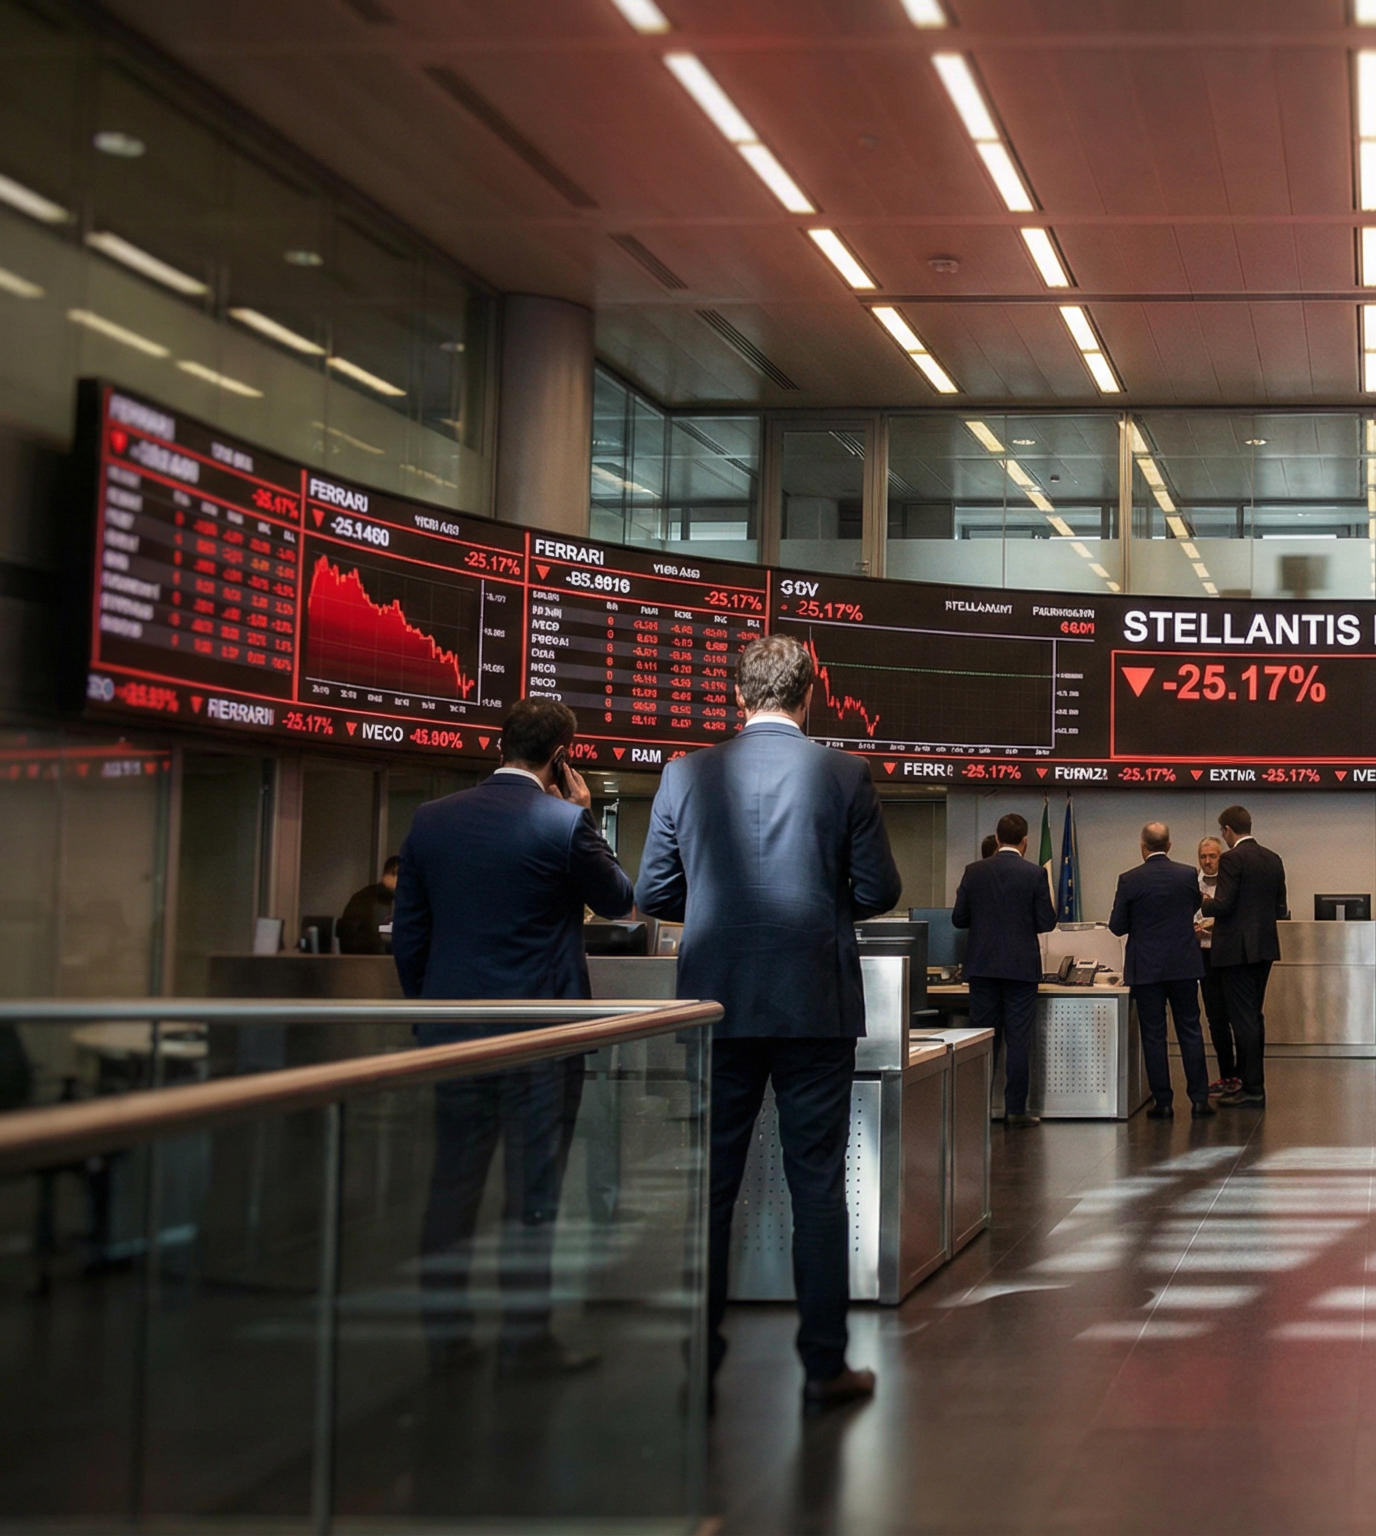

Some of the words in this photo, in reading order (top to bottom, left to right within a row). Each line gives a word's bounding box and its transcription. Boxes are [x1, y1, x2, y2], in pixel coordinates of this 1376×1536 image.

[535, 539, 604, 565] FERRARI
[464, 551, 521, 575] -25.17%
[704, 591, 762, 610] -25.17%
[1123, 611, 1361, 646] STELLANTIS
[1163, 664, 1326, 702] -25.17%
[362, 722, 404, 742] IVECO
[631, 748, 662, 763] RAM
[961, 763, 1021, 779] -25.17%
[1117, 767, 1177, 782] -25.17%
[1262, 768, 1321, 782] -25.17%
